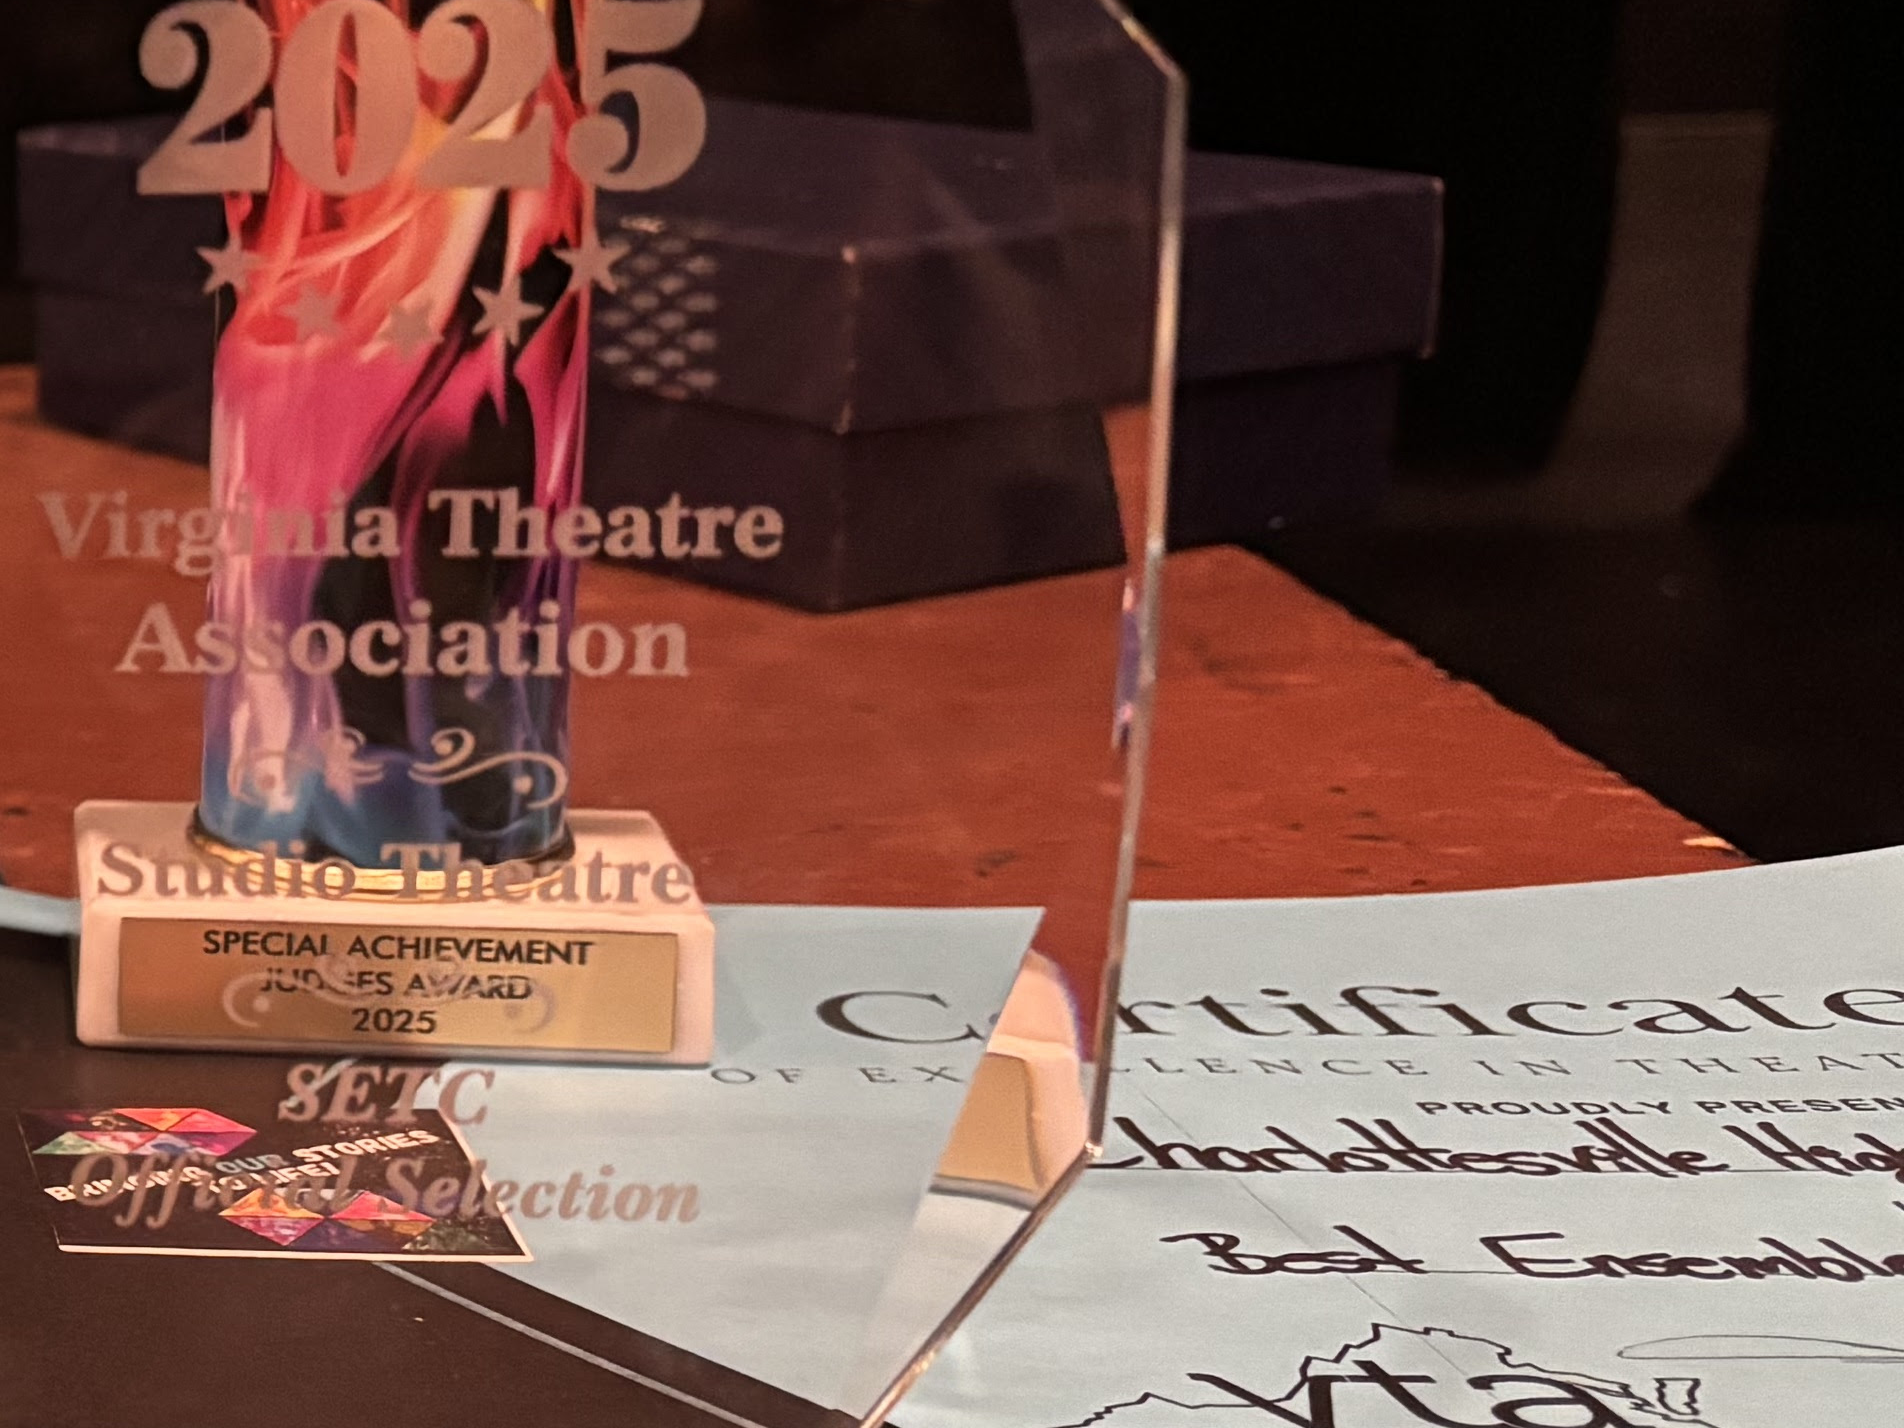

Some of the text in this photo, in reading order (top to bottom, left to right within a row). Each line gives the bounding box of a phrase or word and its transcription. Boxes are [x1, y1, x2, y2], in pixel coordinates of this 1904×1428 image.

[38, 486, 784, 574] Virginia Theatre
[116, 599, 691, 679] Association
[97, 841, 695, 905] Studio Theatre
[202, 929, 594, 966] SPECIAL ACHIEVEMENT
[404, 971, 532, 1000] AWARD
[351, 1006, 437, 1034] 2025
[816, 983, 1904, 1045] Crtificate
[278, 1058, 496, 1128] SETC
[710, 1067, 803, 1085] OF
[1475, 1058, 1574, 1077] IN
[1415, 1099, 1676, 1117] PROUDLY
[215, 1152, 291, 1175] OUR
[292, 1129, 440, 1163] STORIES
[70, 1149, 702, 1230] Official Selection
[1158, 1223, 1428, 1276] Best
